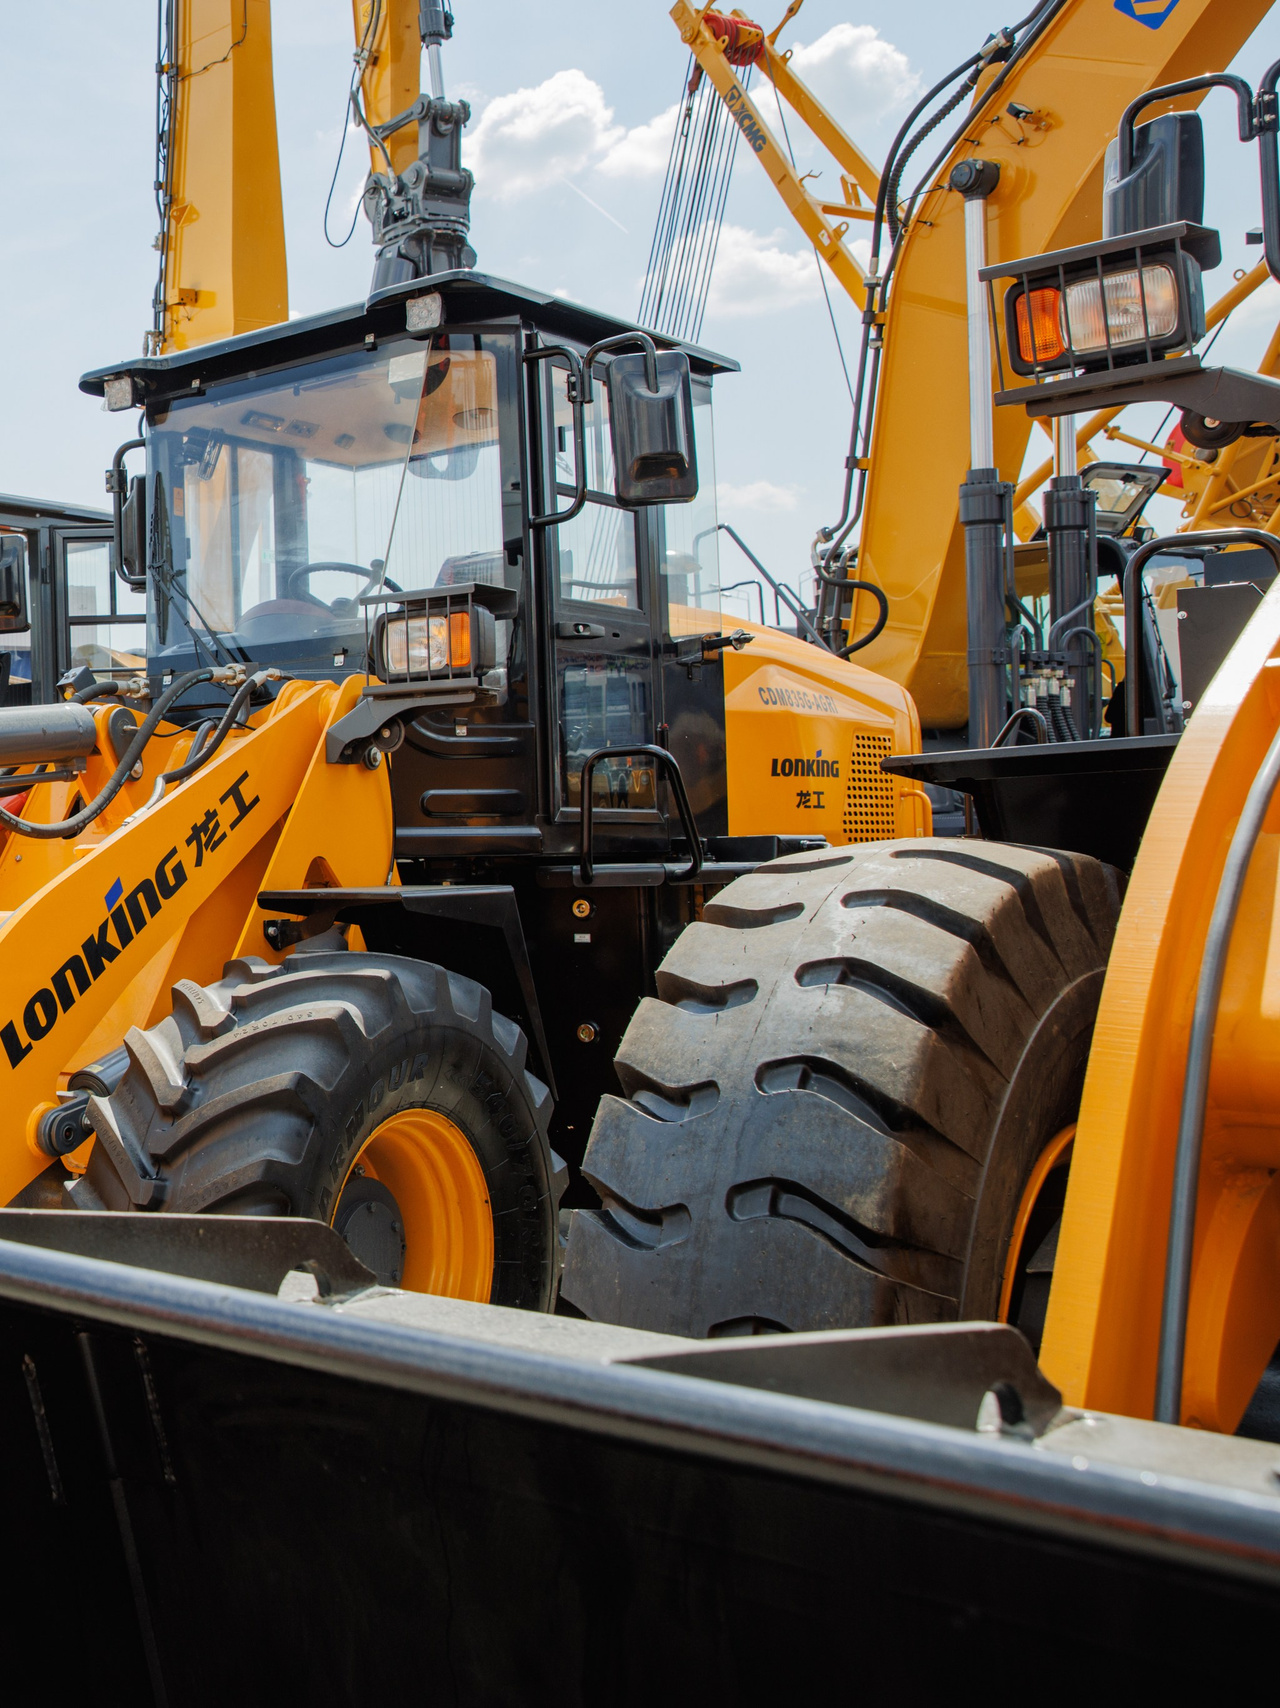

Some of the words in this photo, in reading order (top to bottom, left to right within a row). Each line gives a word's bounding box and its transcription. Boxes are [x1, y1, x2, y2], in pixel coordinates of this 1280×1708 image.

[732, 101, 767, 153] XCMG
[758, 687, 839, 714] CDM835G-AGRI
[771, 749, 840, 778] LONKING
[796, 790, 826, 810] 龙工
[0, 846, 188, 1070] LONKING
[185, 770, 261, 868] 龙工
